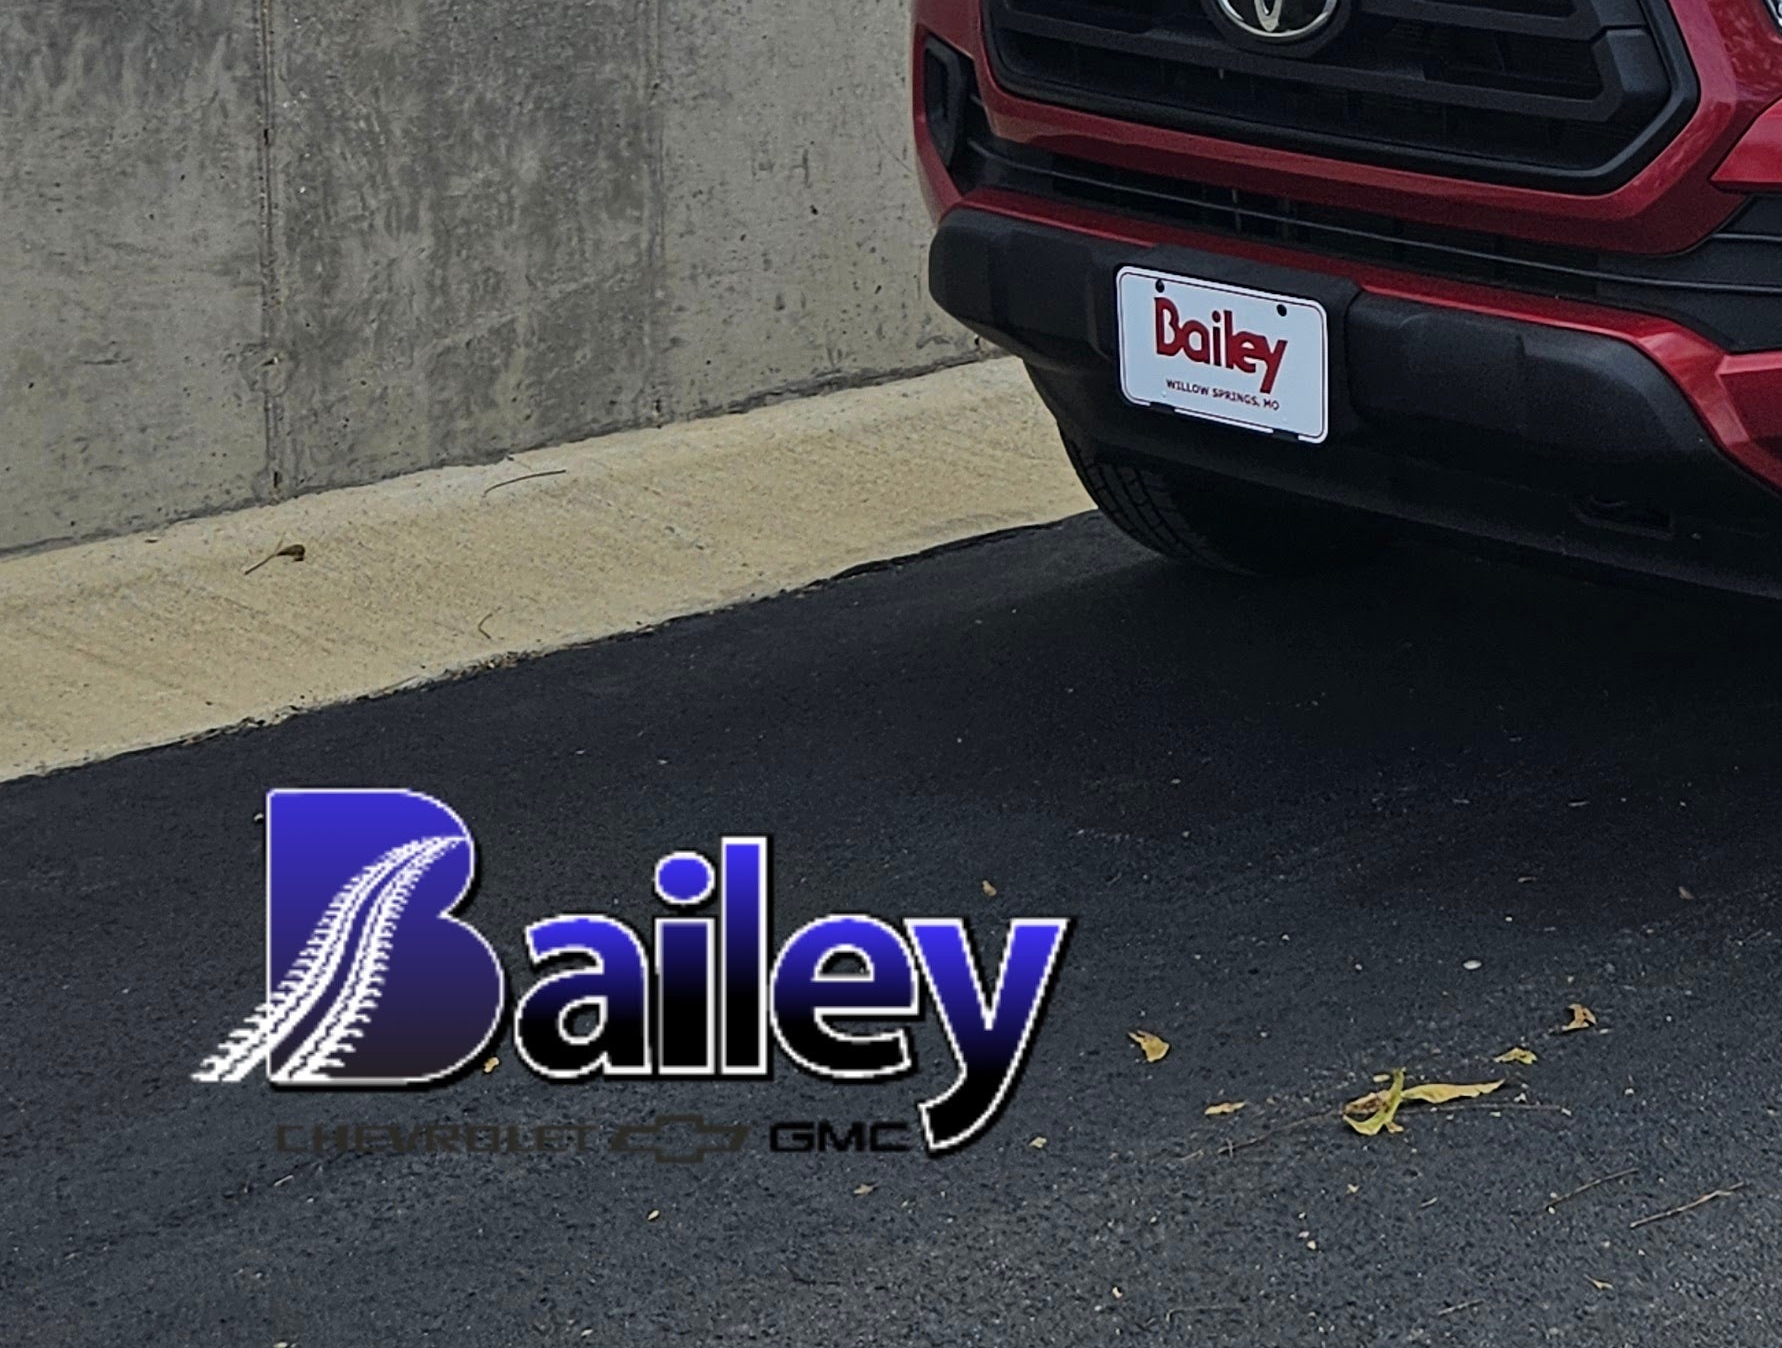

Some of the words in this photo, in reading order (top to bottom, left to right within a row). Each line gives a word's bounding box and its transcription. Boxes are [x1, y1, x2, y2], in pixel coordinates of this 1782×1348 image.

[1154, 297, 1288, 394] Bailey
[1165, 379, 1209, 396] WILLOW
[1263, 399, 1280, 411] MO
